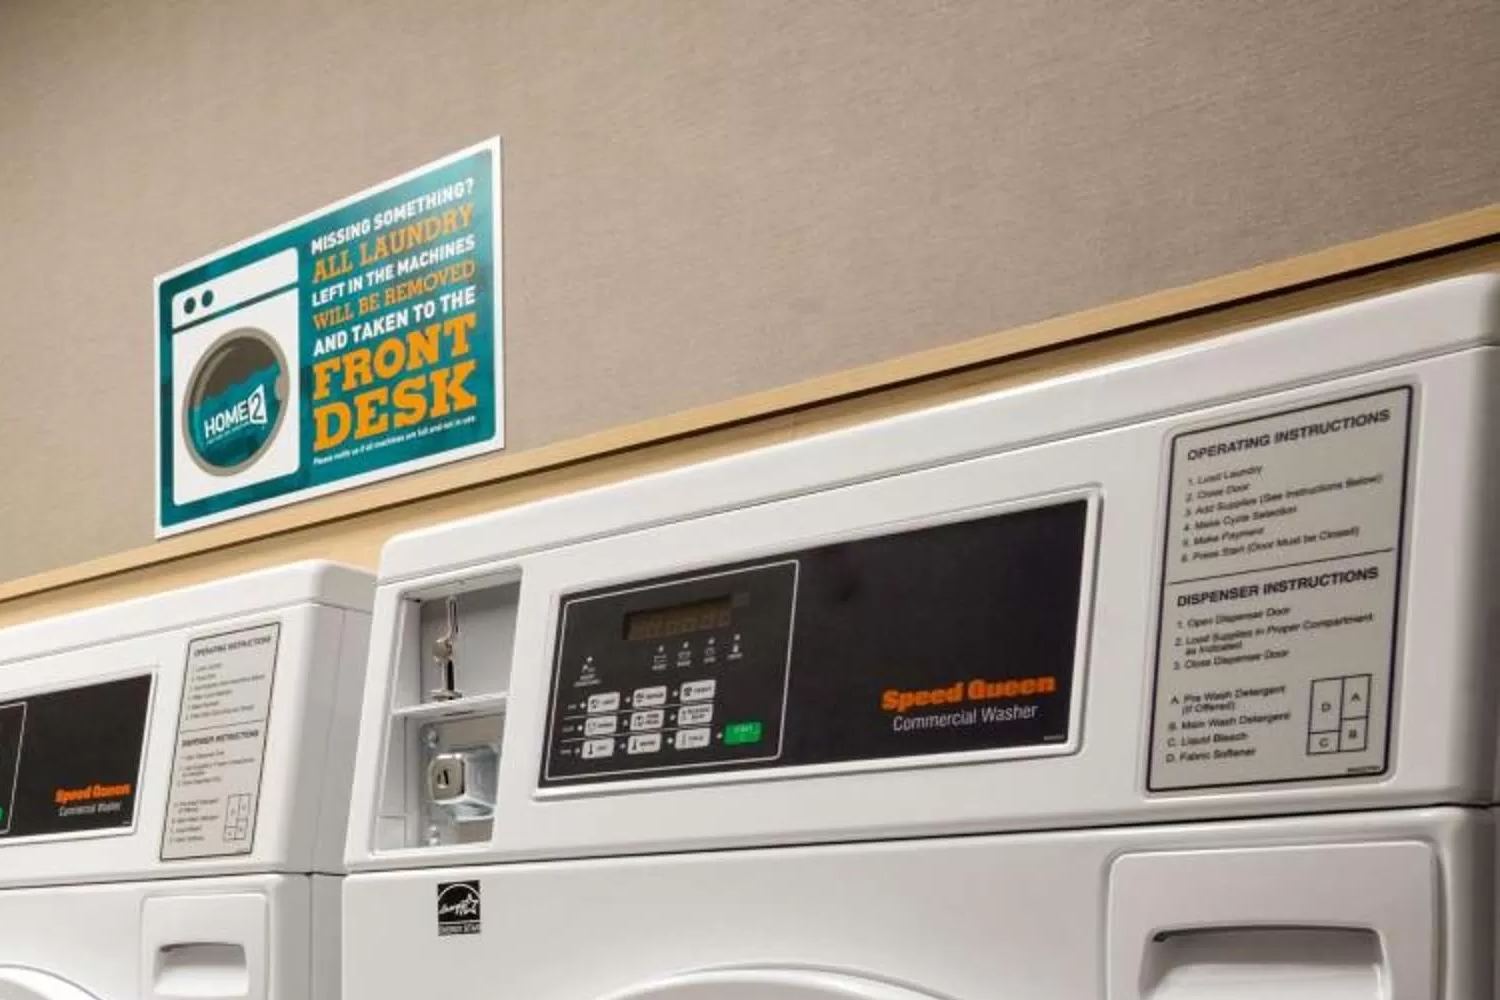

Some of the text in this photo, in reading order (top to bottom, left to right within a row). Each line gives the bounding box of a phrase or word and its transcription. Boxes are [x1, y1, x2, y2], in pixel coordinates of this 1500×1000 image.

[311, 177, 474, 255] MISSING SOMETHING?
[312, 202, 475, 284] ALL LAUNDRY
[312, 233, 476, 307] LEFT IN THE MACHINES
[313, 259, 476, 330] WILL BE REMOVED
[313, 285, 477, 357] AND TAKEN TO THE
[313, 312, 477, 400] FRONT
[313, 359, 477, 453] DESK
[1187, 408, 1391, 461] OPERATING INSTRUCTIONS
[1223, 464, 1264, 481] Laundry
[1226, 483, 1250, 495] Door
[1192, 550, 1219, 560] Press
[1222, 545, 1244, 556] Start
[1247, 540, 1275, 555] (Door
[1276, 536, 1301, 547] Must
[1303, 533, 1317, 544] be
[1319, 525, 1360, 541] Closed)
[1177, 566, 1379, 608] DISPENSER INSTRUCTIONS
[1185, 634, 1210, 645] Load
[1212, 629, 1253, 642] Supplies
[1255, 627, 1265, 636] in
[1267, 622, 1301, 636] Proper
[1302, 612, 1373, 631] Compartment
[1187, 617, 1213, 629] Open
[1215, 610, 1264, 625] Dispenser
[1266, 606, 1291, 617] Door
[1184, 657, 1211, 669] Close
[1214, 651, 1261, 666] Dispenser
[1264, 648, 1290, 660] Door
[882, 677, 1055, 712] Speed Queen
[1204, 690, 1232, 701] Wash
[1235, 685, 1287, 700] Detergent
[1321, 702, 1331, 713] D
[1351, 692, 1360, 702] A
[893, 704, 1039, 732] Commercial Washer
[1319, 738, 1329, 749] C
[1348, 729, 1358, 739] B
[1179, 750, 1210, 763] Fabric
[1213, 748, 1257, 760] Softener
[55, 783, 132, 806] Speed Queen
